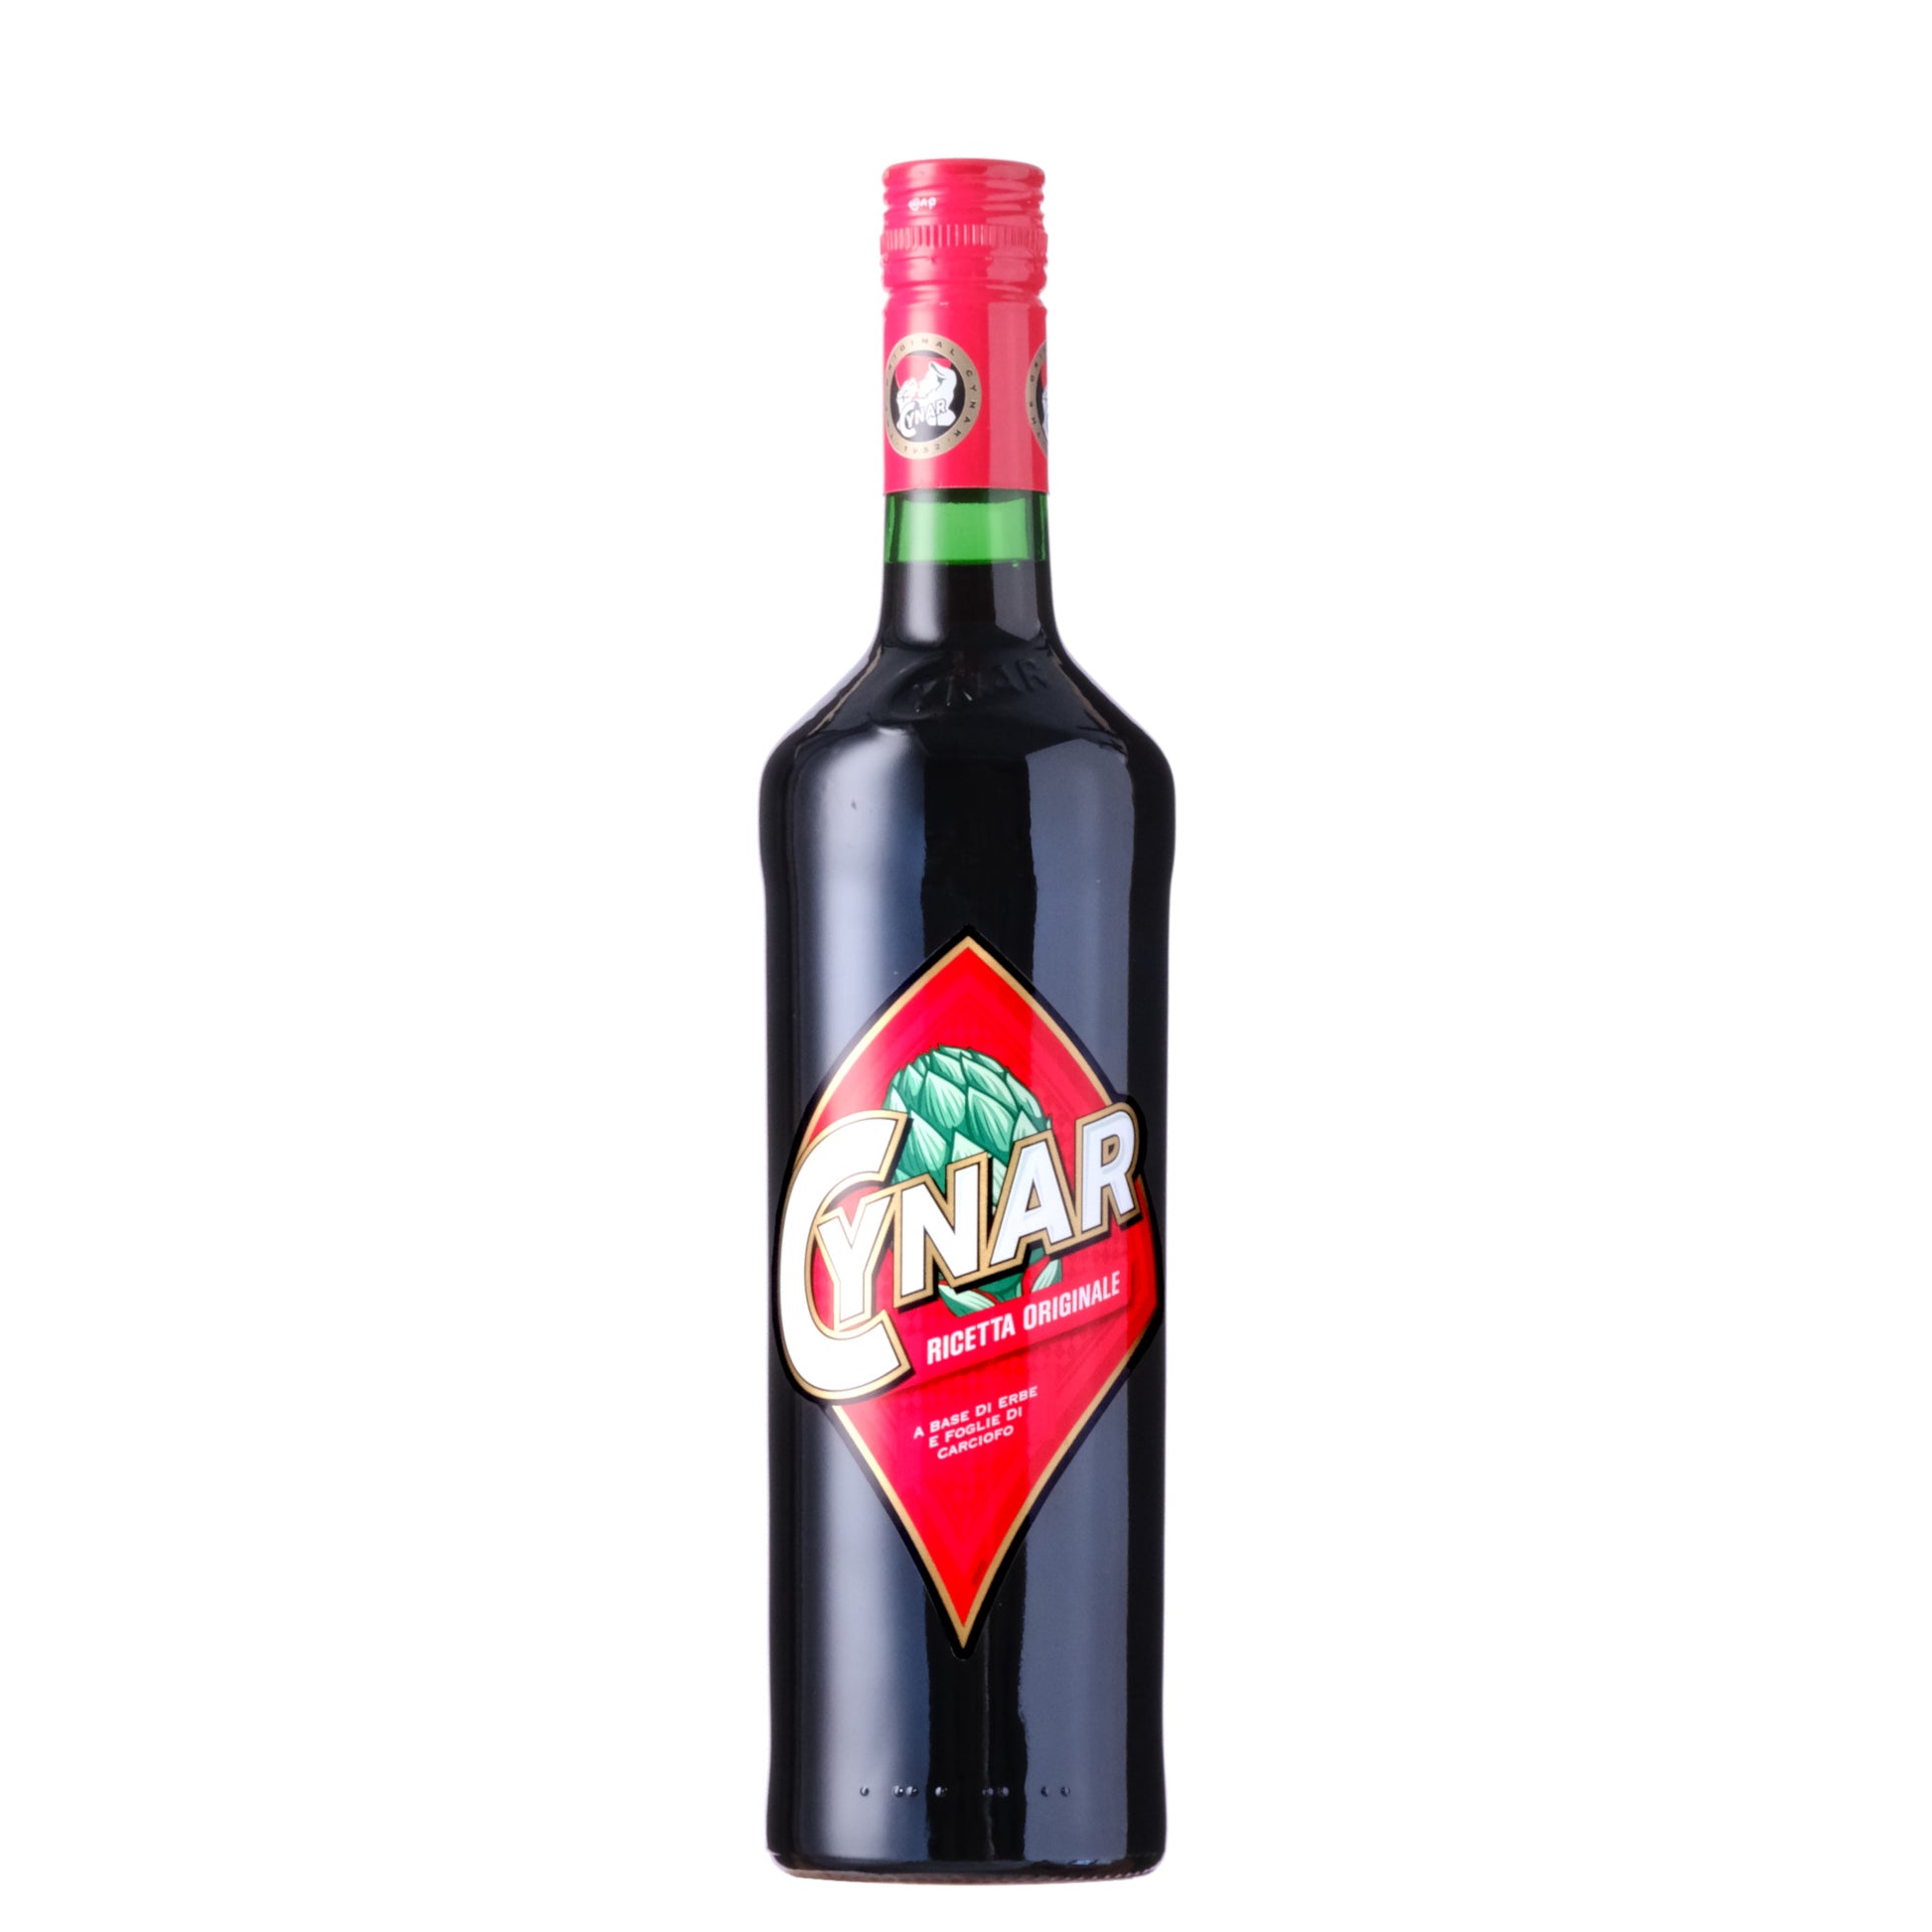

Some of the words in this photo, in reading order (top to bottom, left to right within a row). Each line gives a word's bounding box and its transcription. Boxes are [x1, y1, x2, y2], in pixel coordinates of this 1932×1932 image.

[778, 1103, 1141, 1399] CYNAR
[926, 1313, 1016, 1365] RICETTA
[1024, 1271, 1120, 1330] ORIGINALE
[913, 1426, 924, 1439] A
[929, 1411, 969, 1433] BASE
[975, 1403, 992, 1417] DI
[998, 1386, 1037, 1409] ERBE
[928, 1436, 938, 1449] E
[945, 1415, 1001, 1443] FOGLIE
[1007, 1407, 1023, 1421] DI
[937, 1426, 1014, 1459] CARCIOFO
